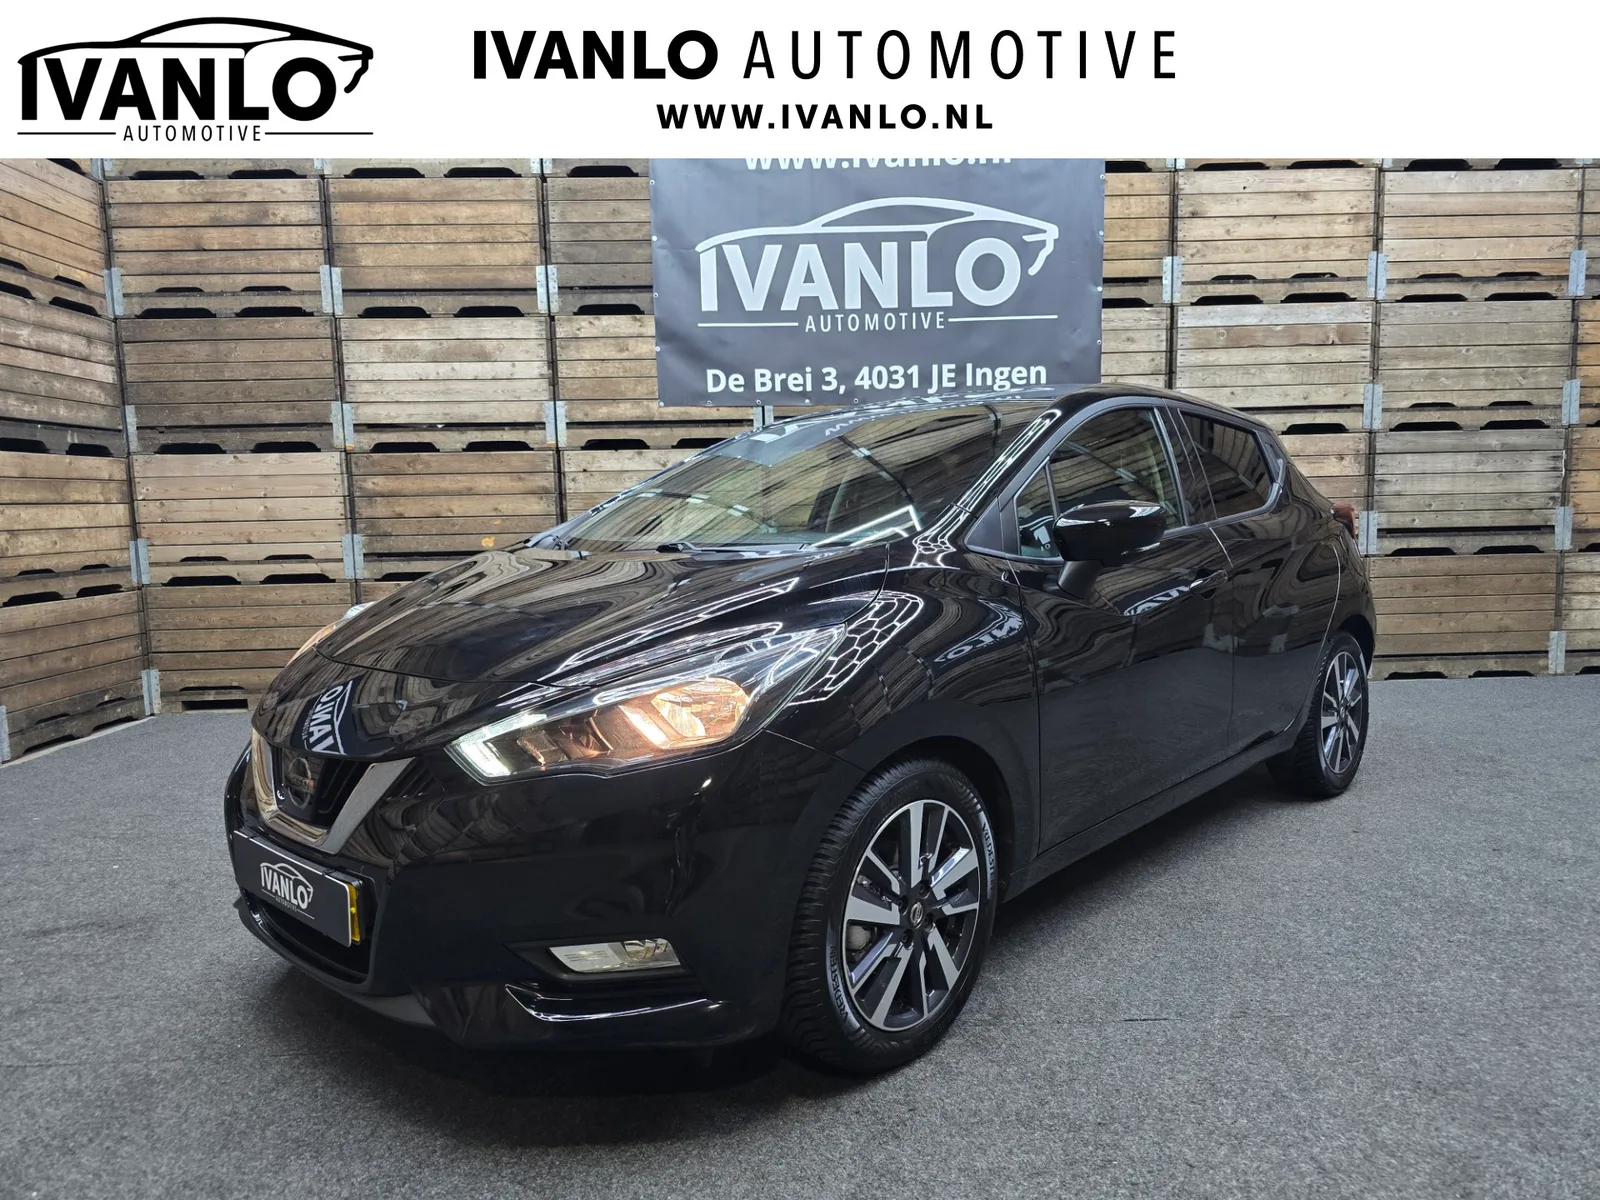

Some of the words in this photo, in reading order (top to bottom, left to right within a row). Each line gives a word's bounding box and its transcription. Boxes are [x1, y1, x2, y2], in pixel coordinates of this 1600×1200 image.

[700, 238, 1022, 312] IVANLO
[805, 312, 945, 333] AUTOMOTIVE
[707, 368, 745, 393] De
[755, 367, 813, 392] Brei
[821, 366, 846, 395] 3,
[854, 365, 919, 390] 4031
[928, 363, 956, 395] JE
[966, 363, 1047, 392] Ingen
[261, 866, 308, 910] IVANLO
